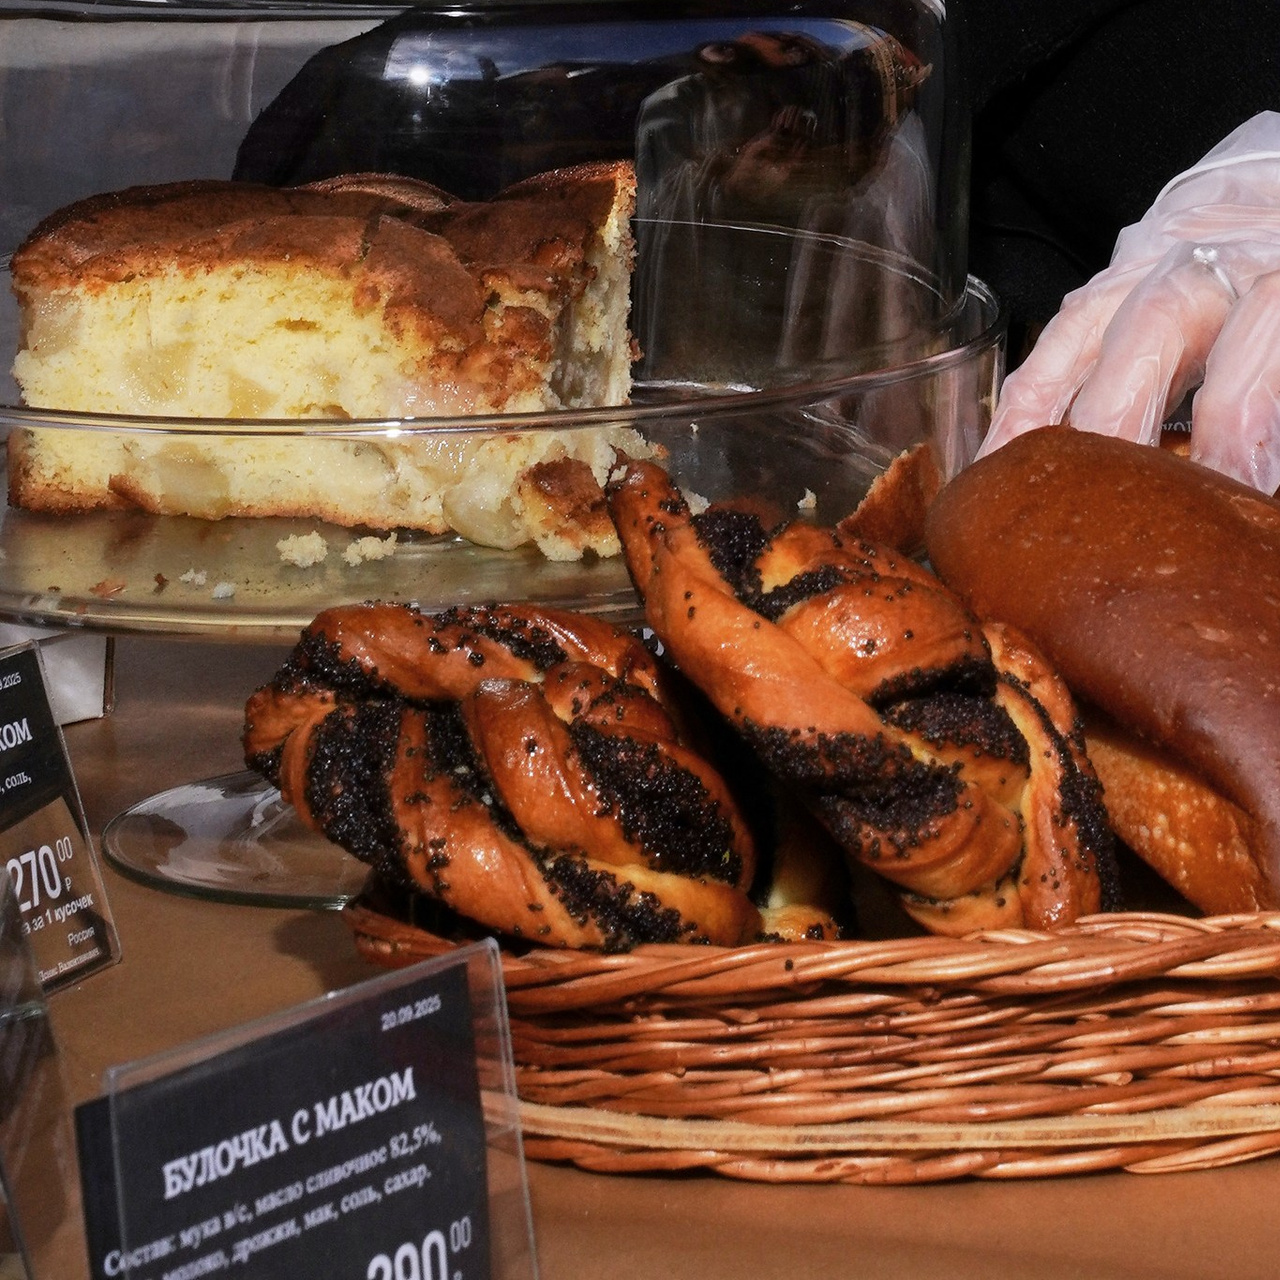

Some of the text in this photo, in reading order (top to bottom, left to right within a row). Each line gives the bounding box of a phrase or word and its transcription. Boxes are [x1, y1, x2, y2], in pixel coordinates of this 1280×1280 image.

[5, 771, 32, 789] соль,
[6, 836, 73, 913] 270 00
[32, 915, 45, 931] за
[45, 909, 52, 924] 1
[55, 893, 94, 923] кусочек
[67, 926, 95, 946] Россия
[380, 994, 441, 1032] 20.09.2025
[162, 1066, 417, 1200] БУЛОЧКА С МАКОМ
[341, 1185, 382, 1213] соль,
[450, 1216, 471, 1253] 00
